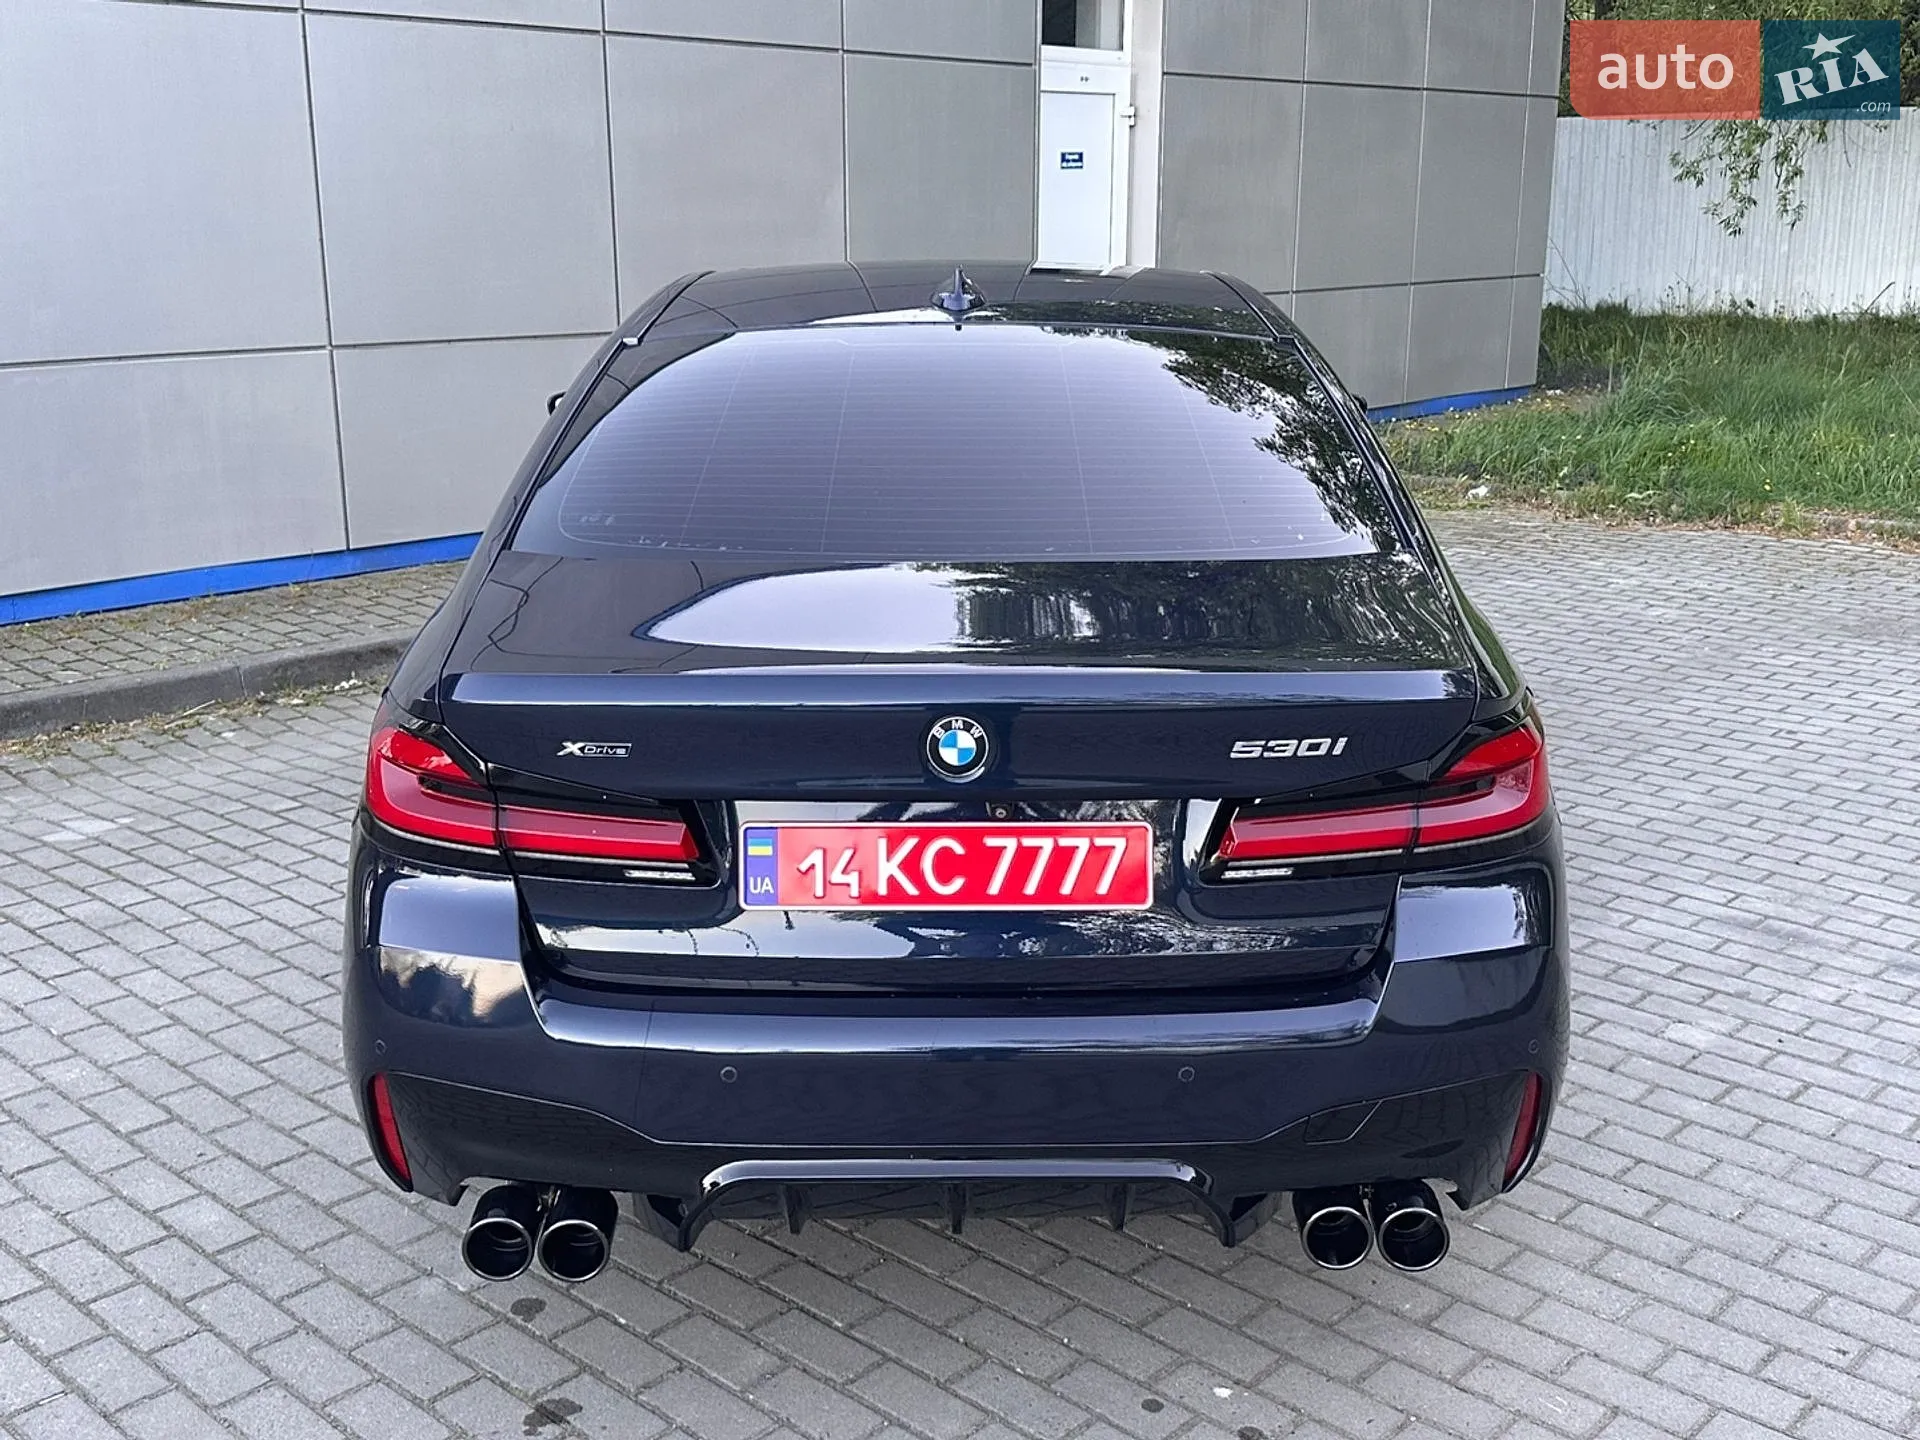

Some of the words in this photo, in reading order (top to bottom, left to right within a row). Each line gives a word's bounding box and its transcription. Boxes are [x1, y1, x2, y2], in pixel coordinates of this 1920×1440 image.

[933, 719, 983, 739] BMW
[797, 847, 860, 899] 14
[876, 836, 966, 896] KC
[983, 836, 1127, 896] 7777
[749, 876, 775, 894] UA
